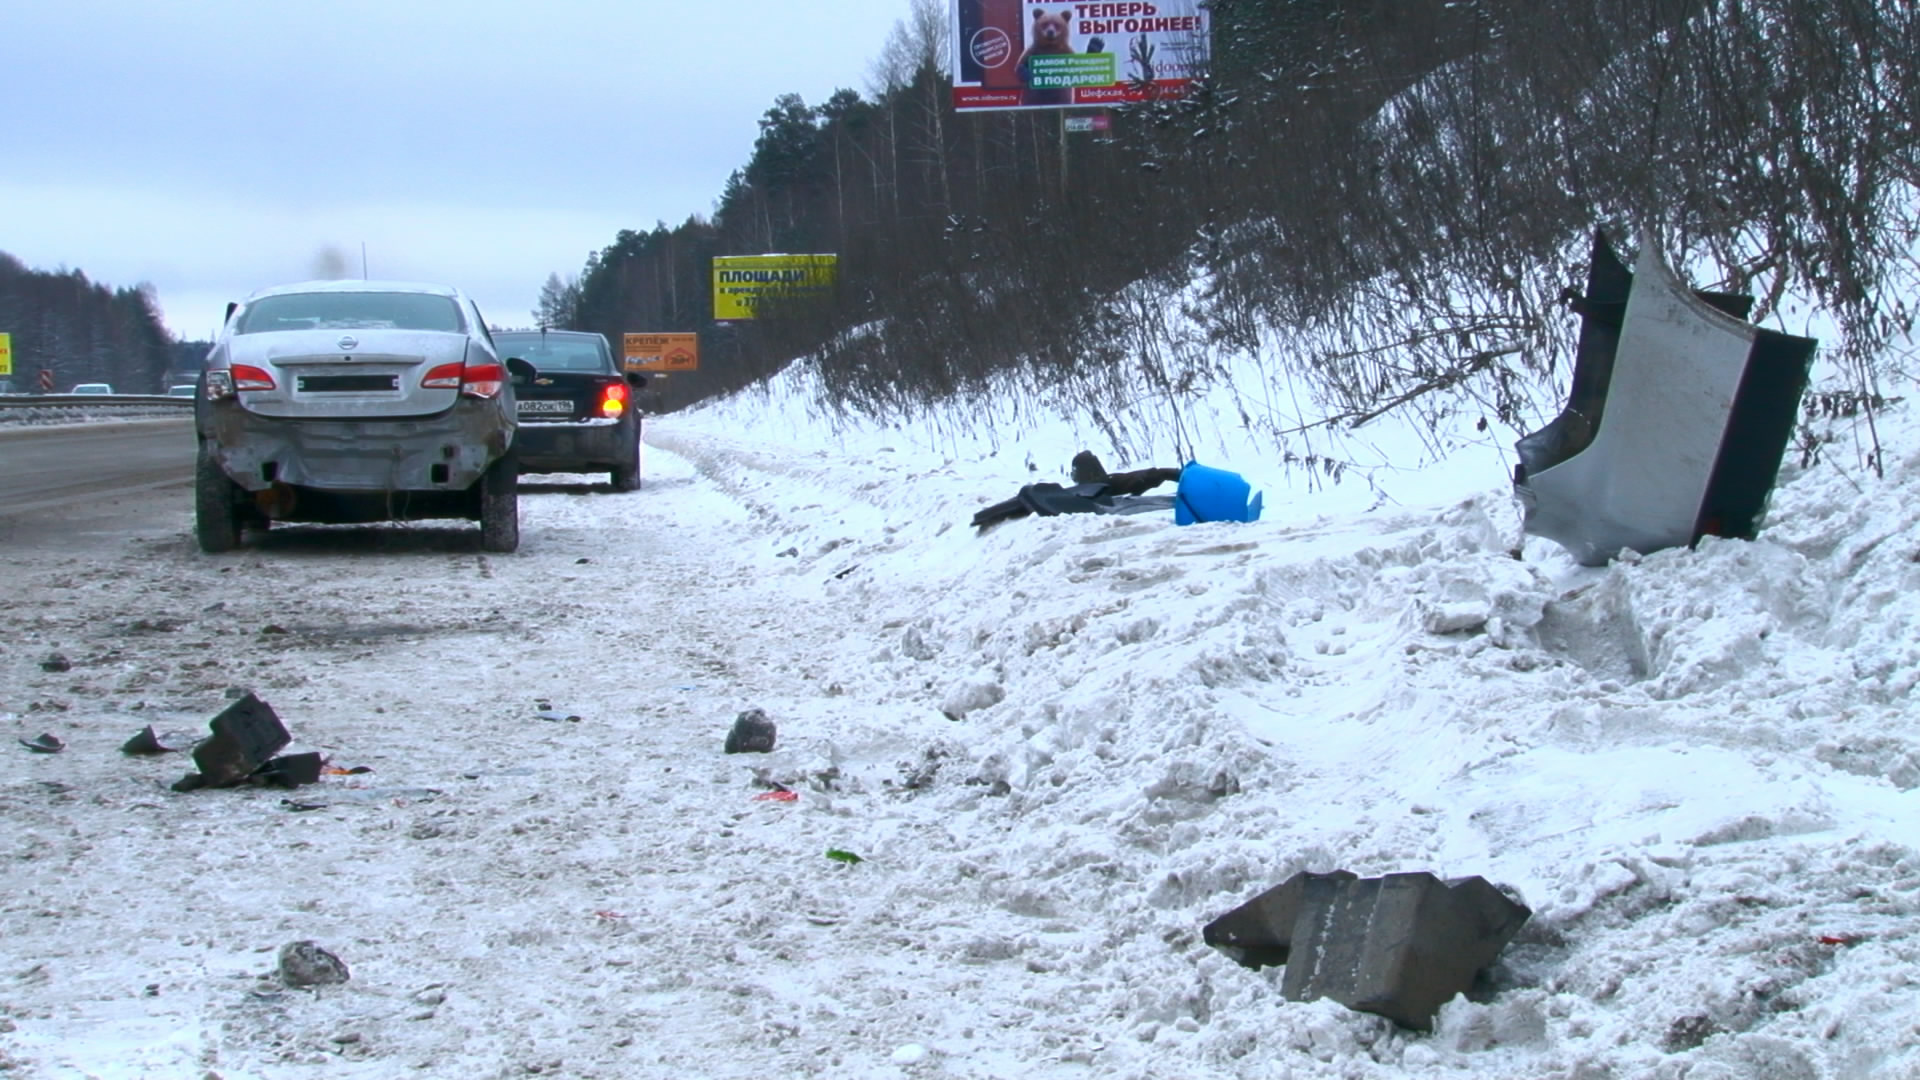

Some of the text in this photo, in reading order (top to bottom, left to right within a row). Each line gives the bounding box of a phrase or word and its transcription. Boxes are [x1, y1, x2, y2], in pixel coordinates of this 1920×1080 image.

[1075, 2, 1156, 19] ТЕПЕРЬ
[1079, 16, 1201, 35] ВЫГОДНЕЕ!
[1033, 58, 1066, 66] ЗАМОК
[1033, 75, 1110, 87] В ПОДАРОК!
[720, 270, 805, 285] ПЛОЩАДИ
